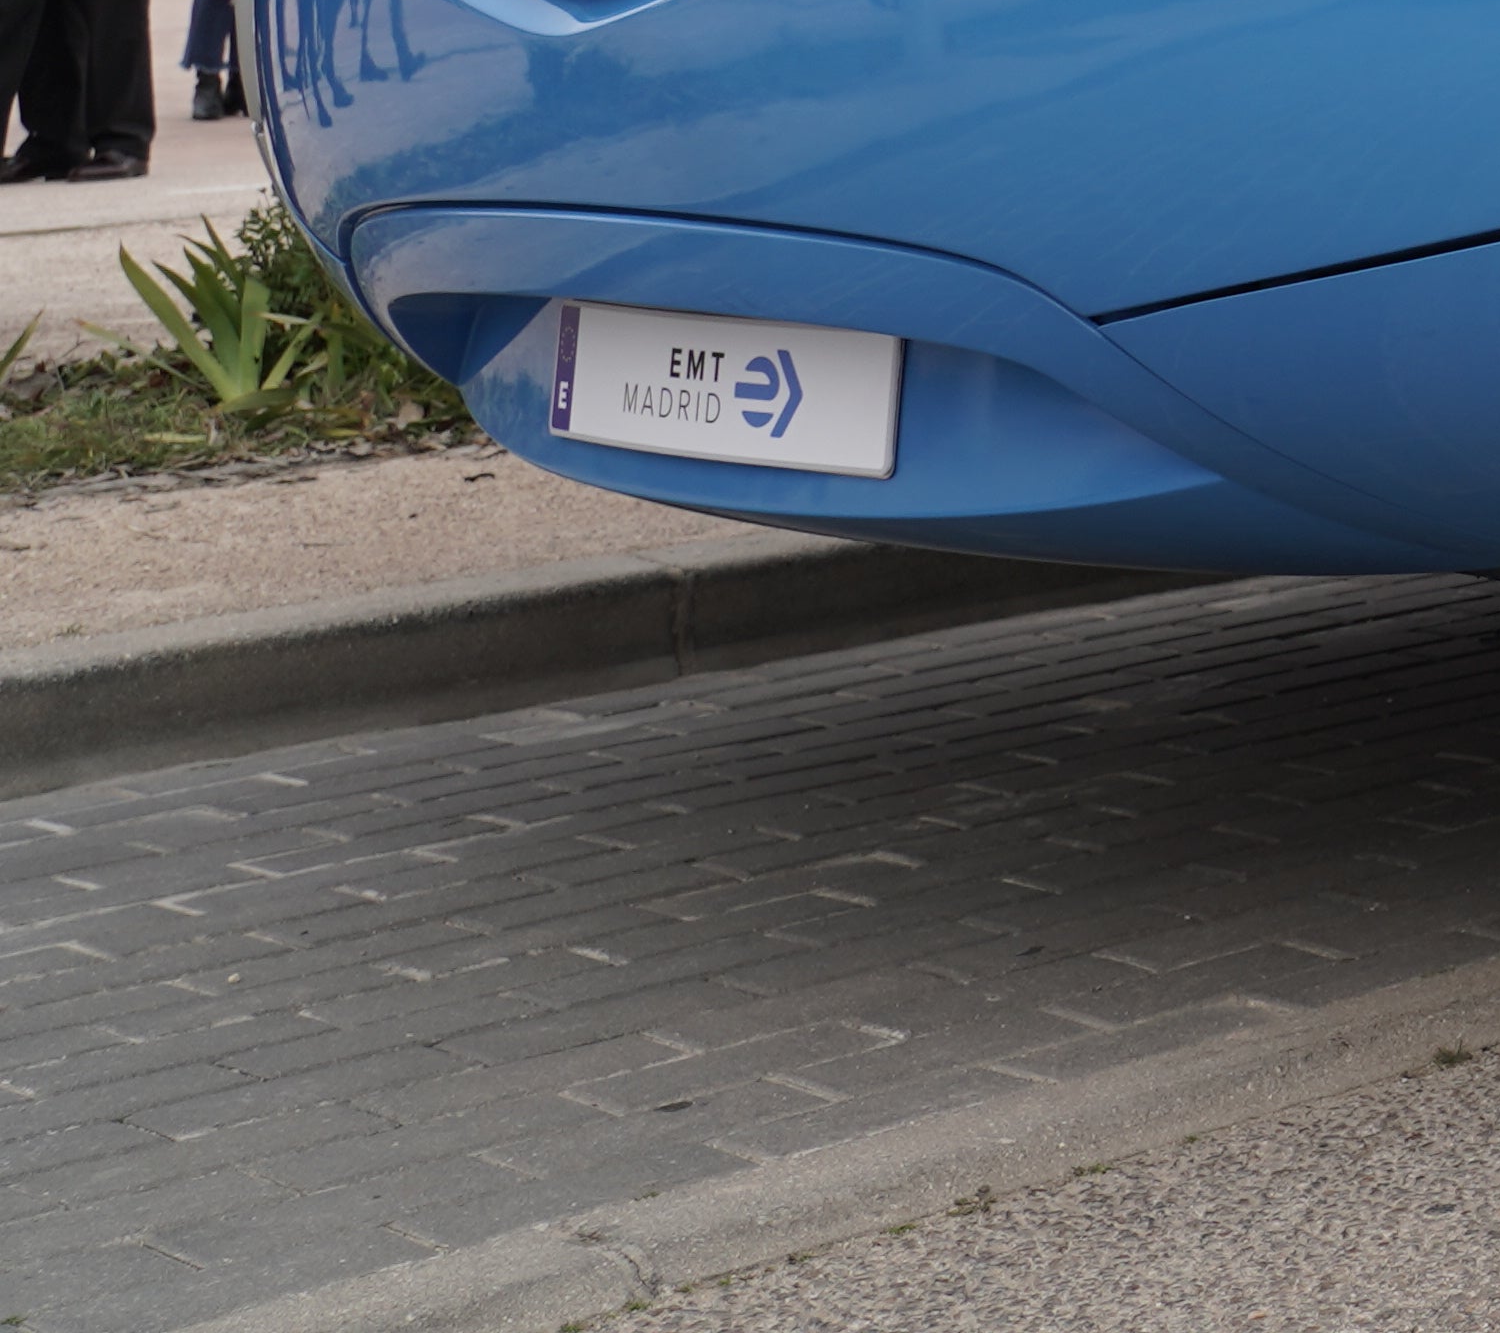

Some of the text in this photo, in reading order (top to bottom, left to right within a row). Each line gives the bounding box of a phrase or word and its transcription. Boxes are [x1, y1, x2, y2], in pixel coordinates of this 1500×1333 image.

[670, 347, 725, 382] EMT
[557, 381, 569, 410] E
[622, 382, 721, 424] MADRID
